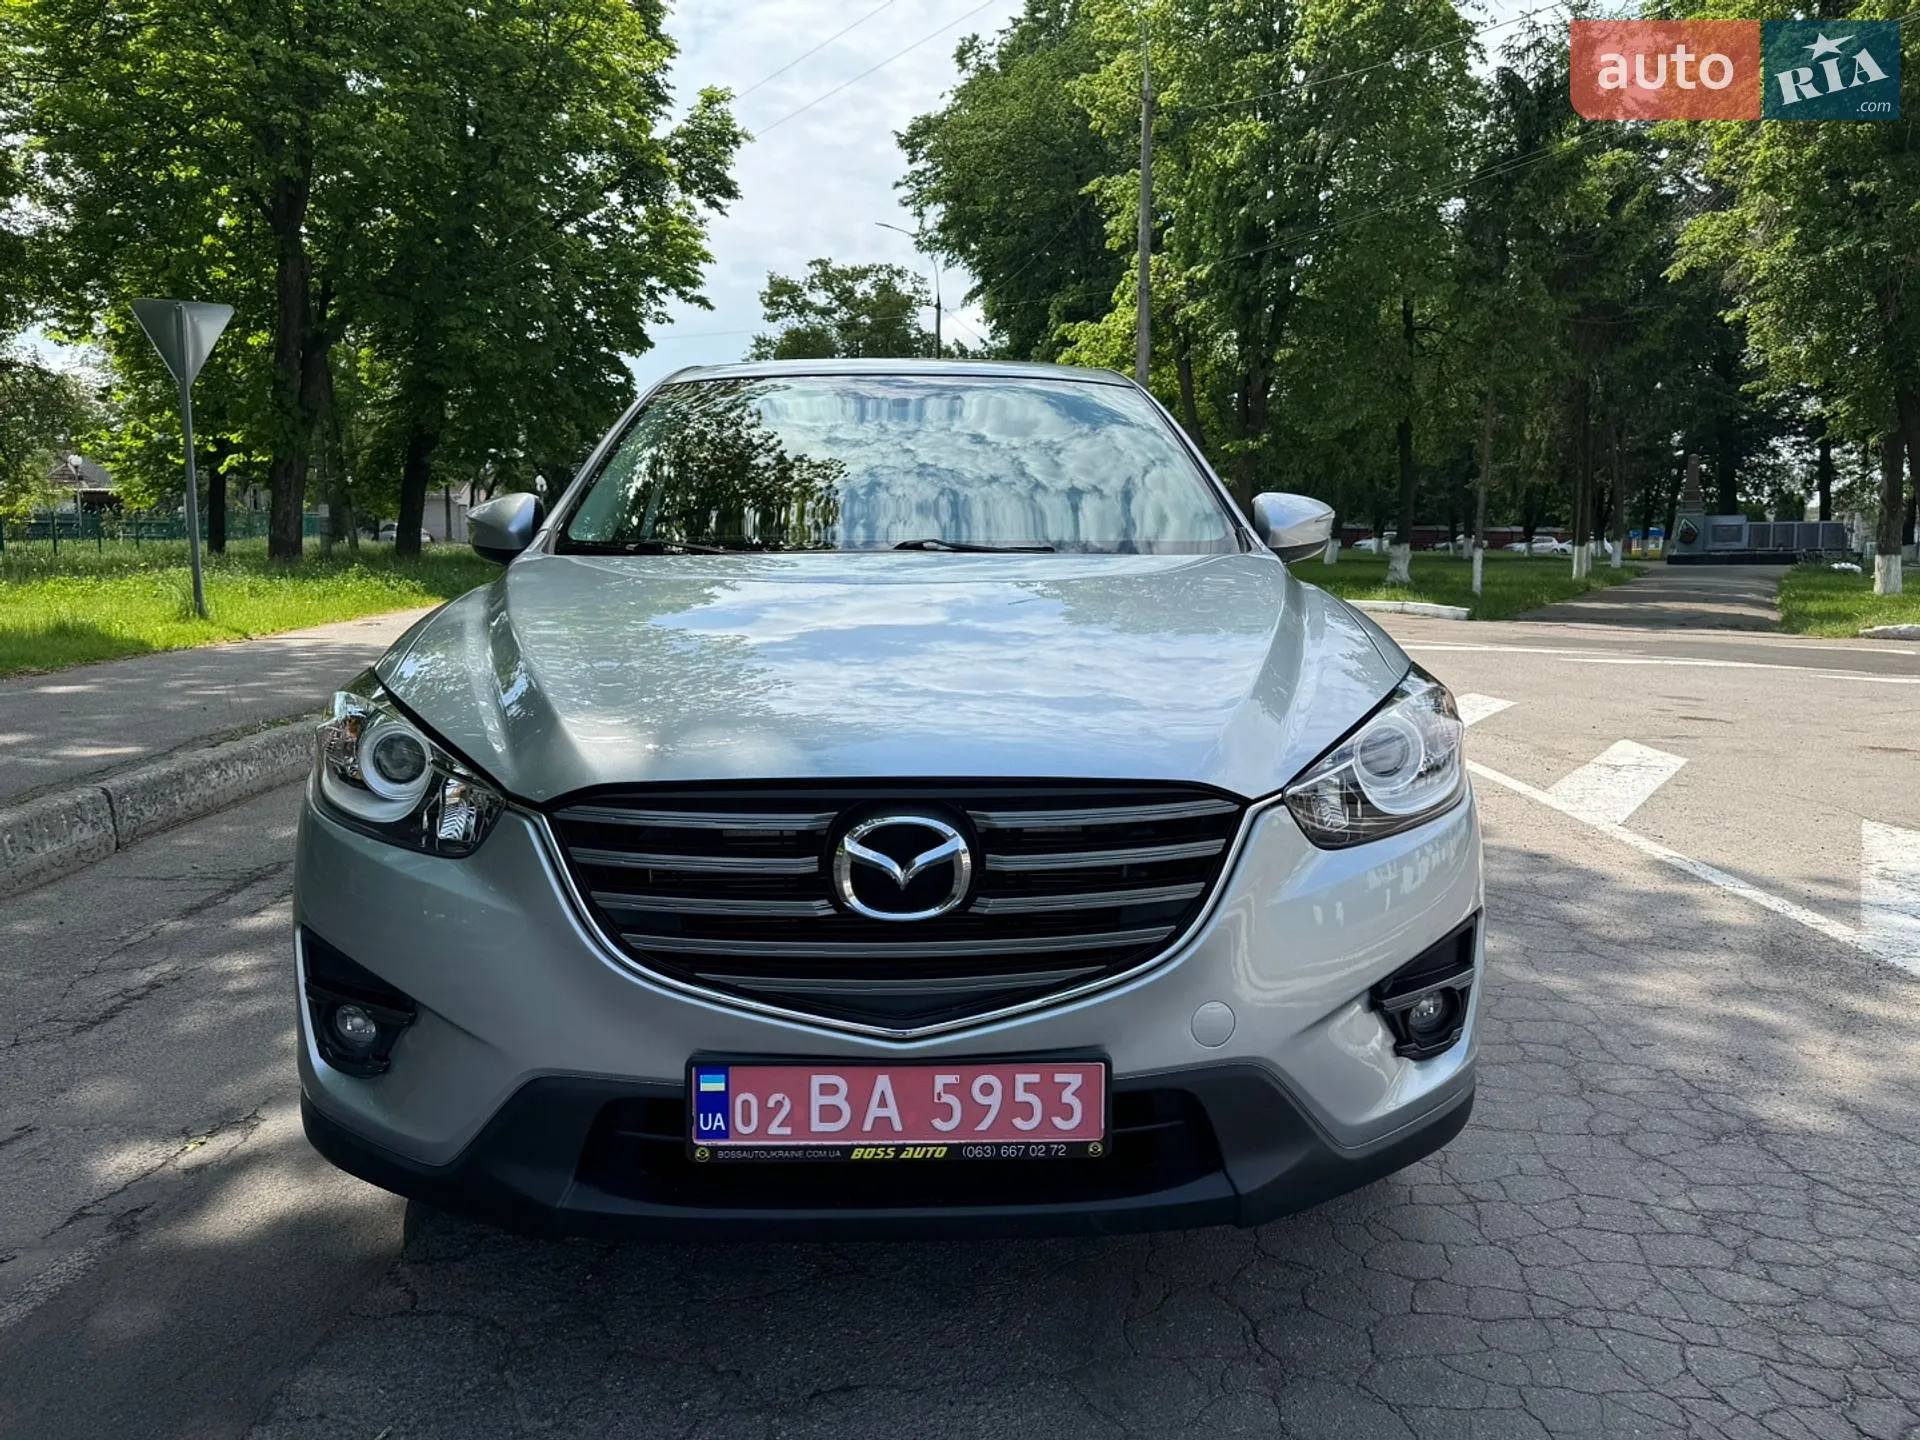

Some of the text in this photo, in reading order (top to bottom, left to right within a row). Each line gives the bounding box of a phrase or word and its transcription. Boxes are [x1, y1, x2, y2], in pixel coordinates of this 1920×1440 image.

[734, 1073, 1083, 1136] 02 BA 5953
[700, 1113, 726, 1131] UA
[850, 1146, 948, 1160] BOSS AUTO
[962, 1144, 1067, 1159] (063) 667 02 72
